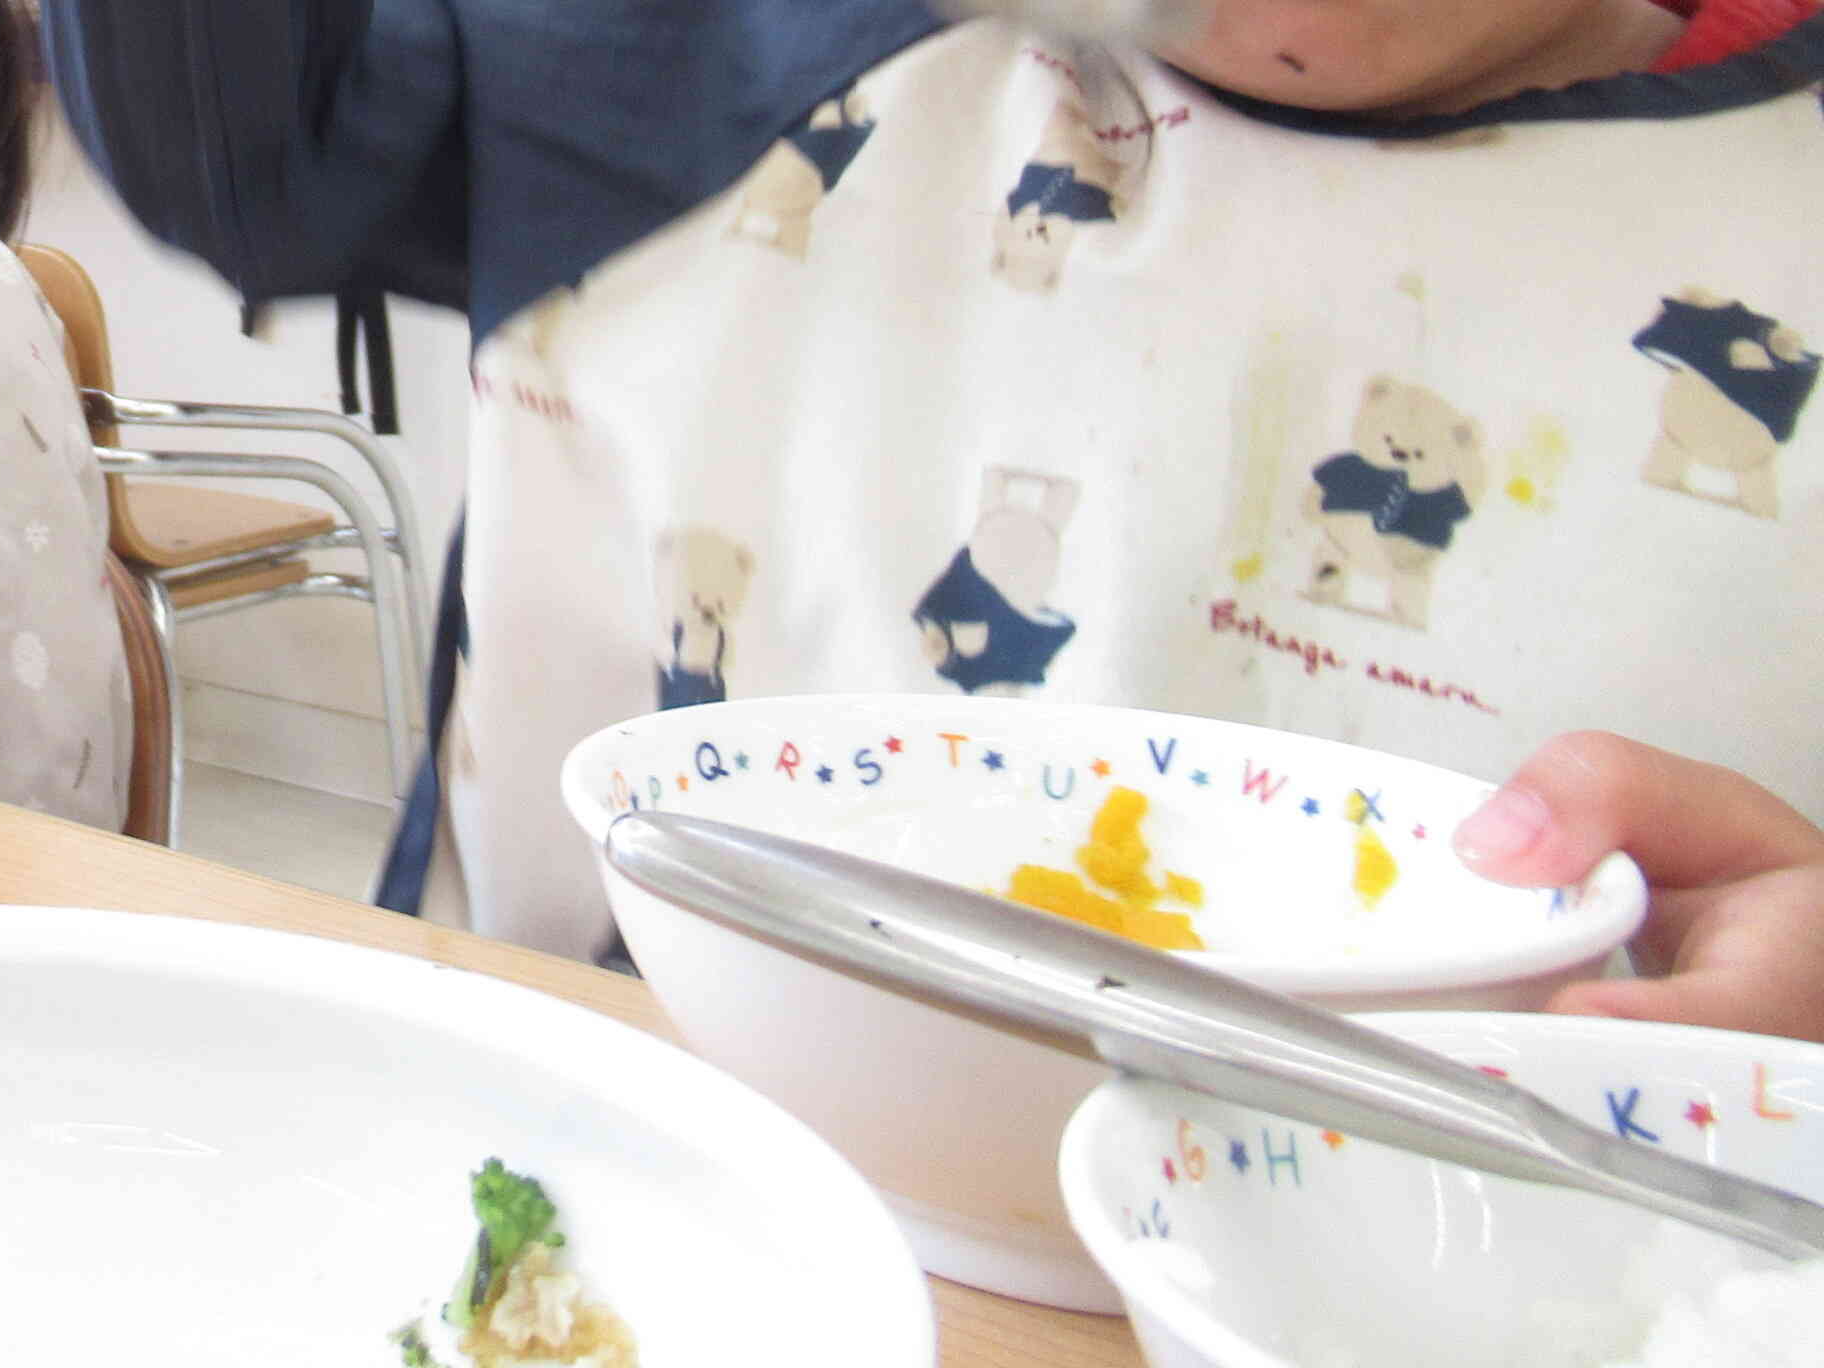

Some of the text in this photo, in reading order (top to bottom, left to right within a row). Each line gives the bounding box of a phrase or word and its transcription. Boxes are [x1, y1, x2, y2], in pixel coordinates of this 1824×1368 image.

[695, 742, 730, 781] Q
[775, 741, 800, 781] R
[854, 749, 883, 786] S
[937, 733, 969, 768] T
[1042, 765, 1075, 801] U
[1147, 738, 1176, 775] V
[1242, 759, 1288, 804] W
[1261, 1127, 1301, 1186] H
[1606, 1088, 1659, 1143] K
[1752, 1063, 1796, 1120] L
